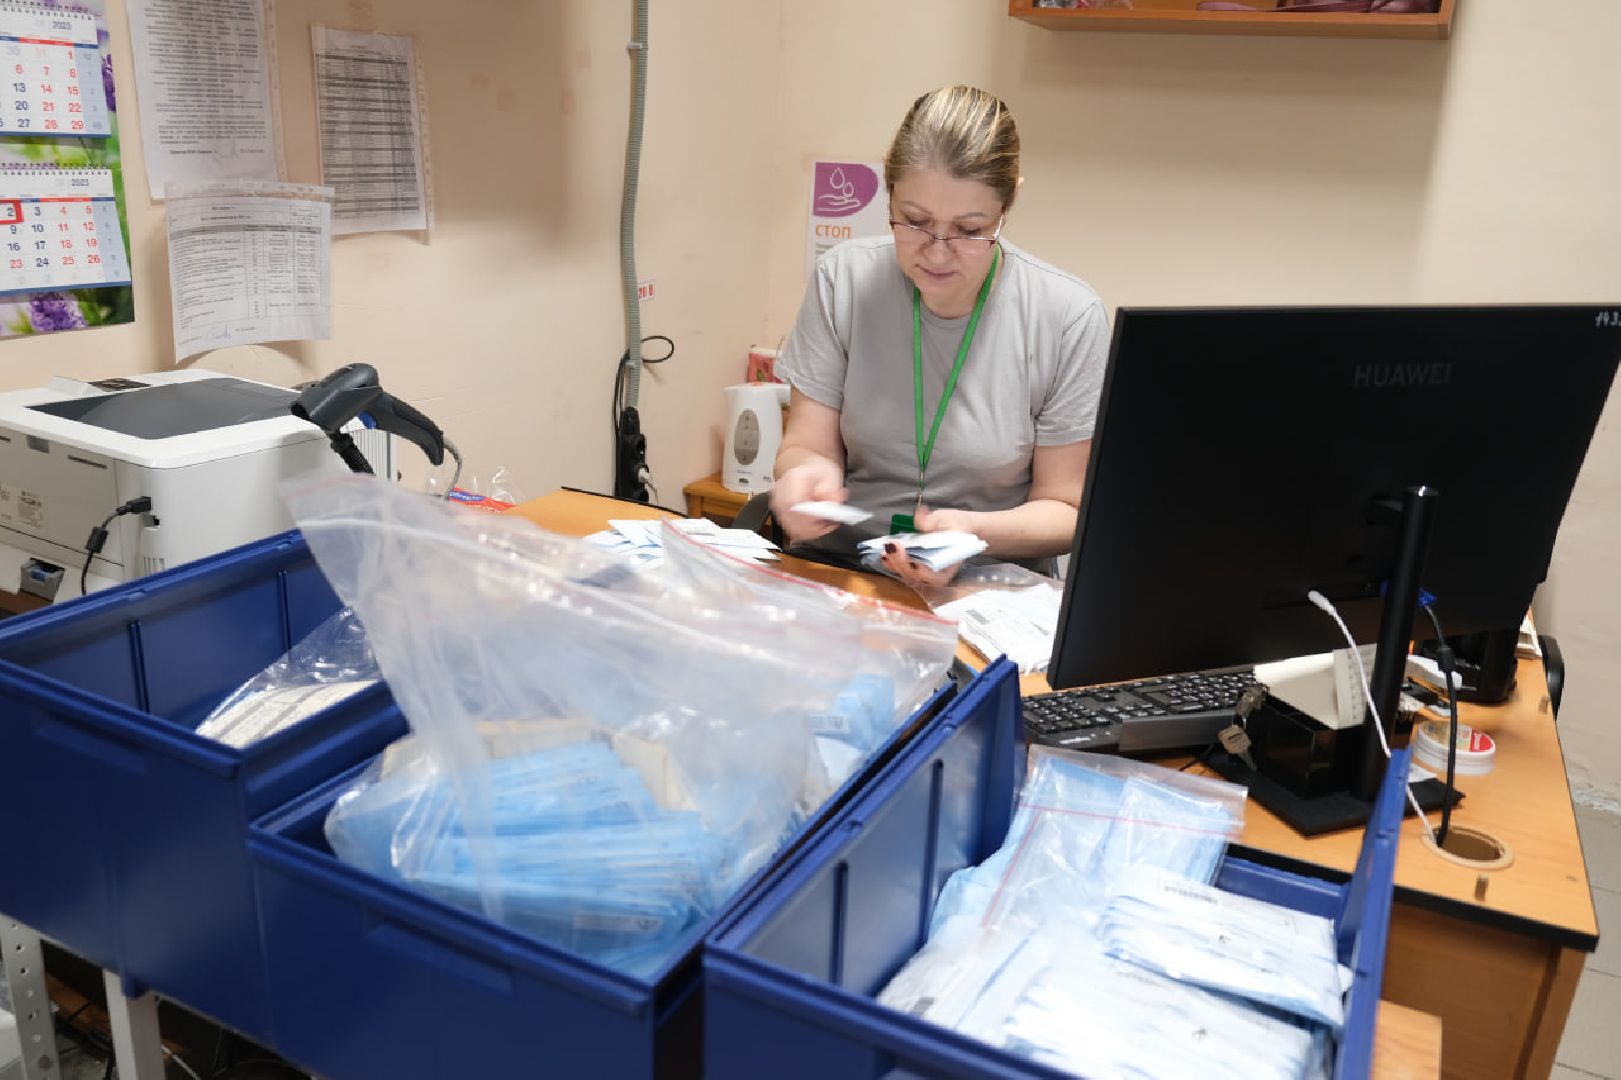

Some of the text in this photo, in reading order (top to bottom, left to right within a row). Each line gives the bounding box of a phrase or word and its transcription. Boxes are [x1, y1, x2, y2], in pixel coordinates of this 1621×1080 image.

[68, 49, 74, 60] 1
[15, 64, 24, 75] 6
[43, 66, 50, 76] 7
[13, 82, 79, 95] 13 14 15
[15, 100, 82, 113] 20 21 22
[17, 118, 31, 128] 27
[44, 119, 58, 130] 28
[71, 120, 84, 130] 29
[71, 178, 90, 187] 2023
[7, 205, 93, 217] 2 3 4 5
[10, 221, 95, 234] 9 10 11 12
[815, 223, 852, 240] СТОП
[8, 238, 98, 252] 16 17 18 19
[9, 254, 101, 269] 23 24 25 26
[1353, 361, 1452, 387] HUAWEI
